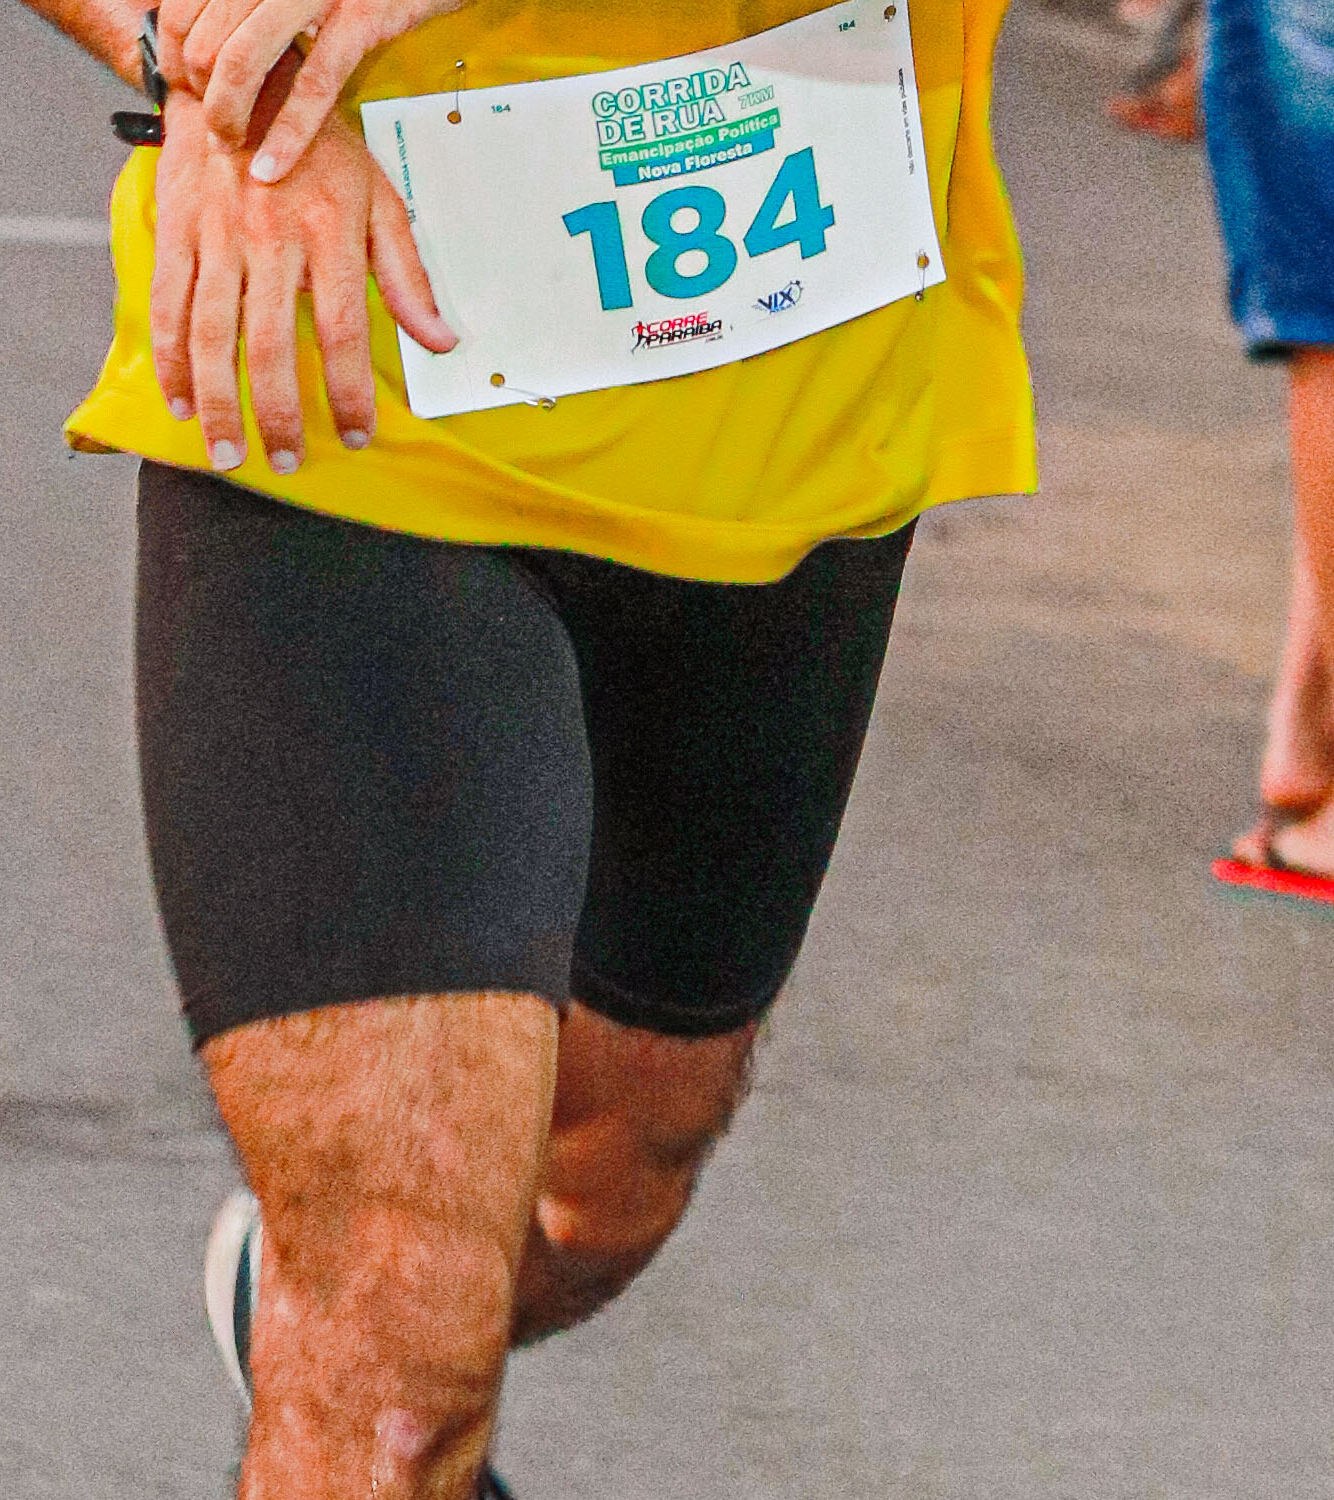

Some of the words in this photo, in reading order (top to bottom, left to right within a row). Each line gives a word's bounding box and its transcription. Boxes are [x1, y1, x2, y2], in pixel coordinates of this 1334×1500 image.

[838, 19, 856, 32] 184
[592, 61, 751, 118] CORRIDA
[738, 85, 775, 110] 7KM
[597, 114, 645, 146] DE
[653, 98, 725, 137] RUA
[601, 133, 714, 167] Emancipação
[719, 112, 778, 142] Política
[638, 163, 682, 181] Nova
[685, 142, 753, 171] Floresta
[562, 146, 836, 311] 184
[757, 287, 796, 311] VIX
[646, 311, 708, 334] CORRE
